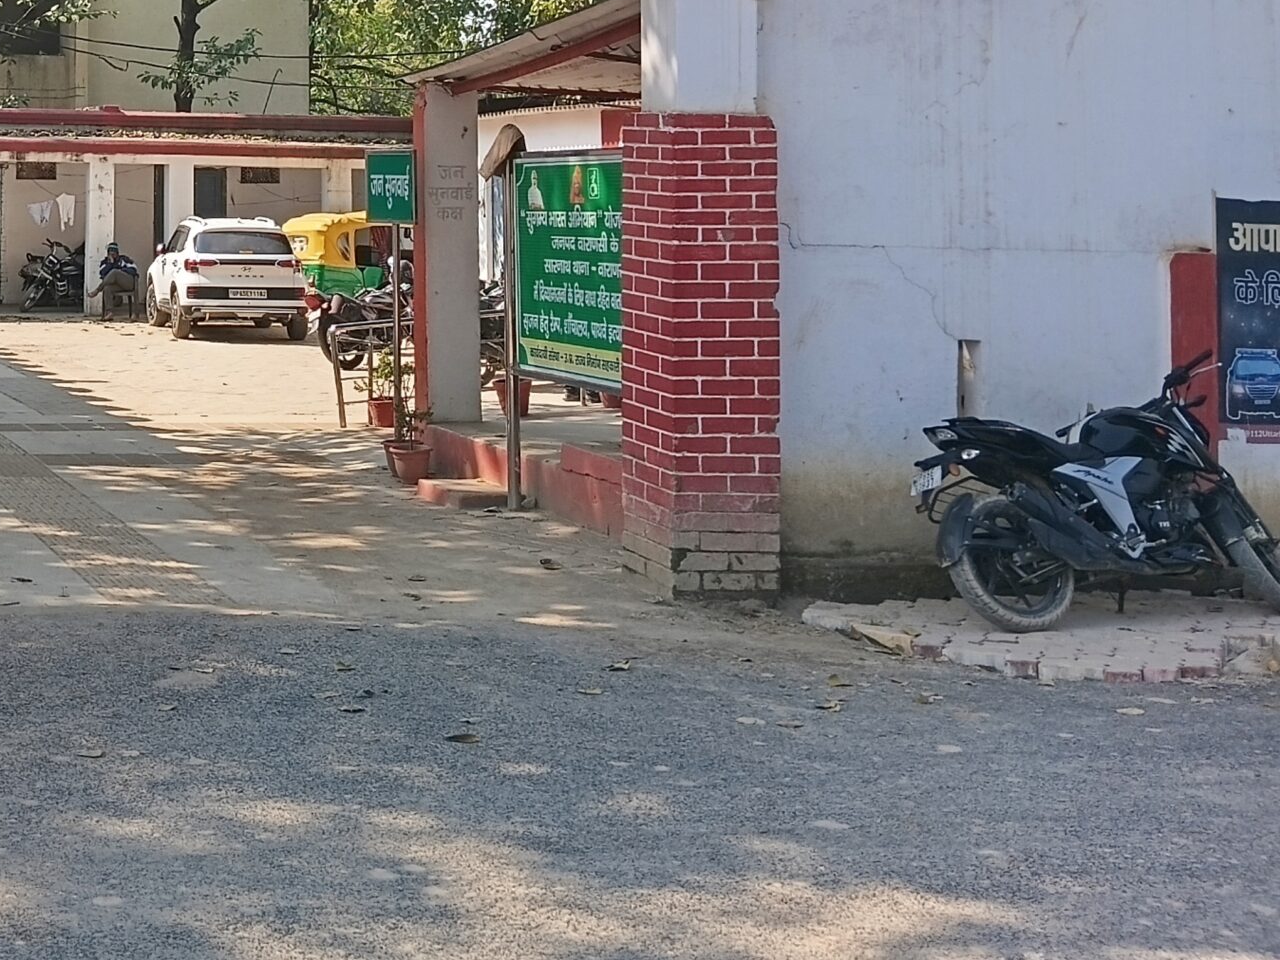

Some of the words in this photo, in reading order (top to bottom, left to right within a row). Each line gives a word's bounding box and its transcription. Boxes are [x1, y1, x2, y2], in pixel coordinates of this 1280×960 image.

[437, 165, 467, 180] जन
[370, 174, 384, 197] जन
[385, 165, 410, 210] सुनवाई
[548, 210, 567, 228] भारत
[550, 235, 576, 251] जनपद
[577, 231, 608, 253] वाराणसी
[609, 232, 620, 253] के
[1228, 222, 1280, 253] आपा
[543, 258, 571, 275] सारनाथ
[572, 261, 590, 276] थाना
[1233, 269, 1260, 305] के
[539, 308, 549, 339] हेतु
